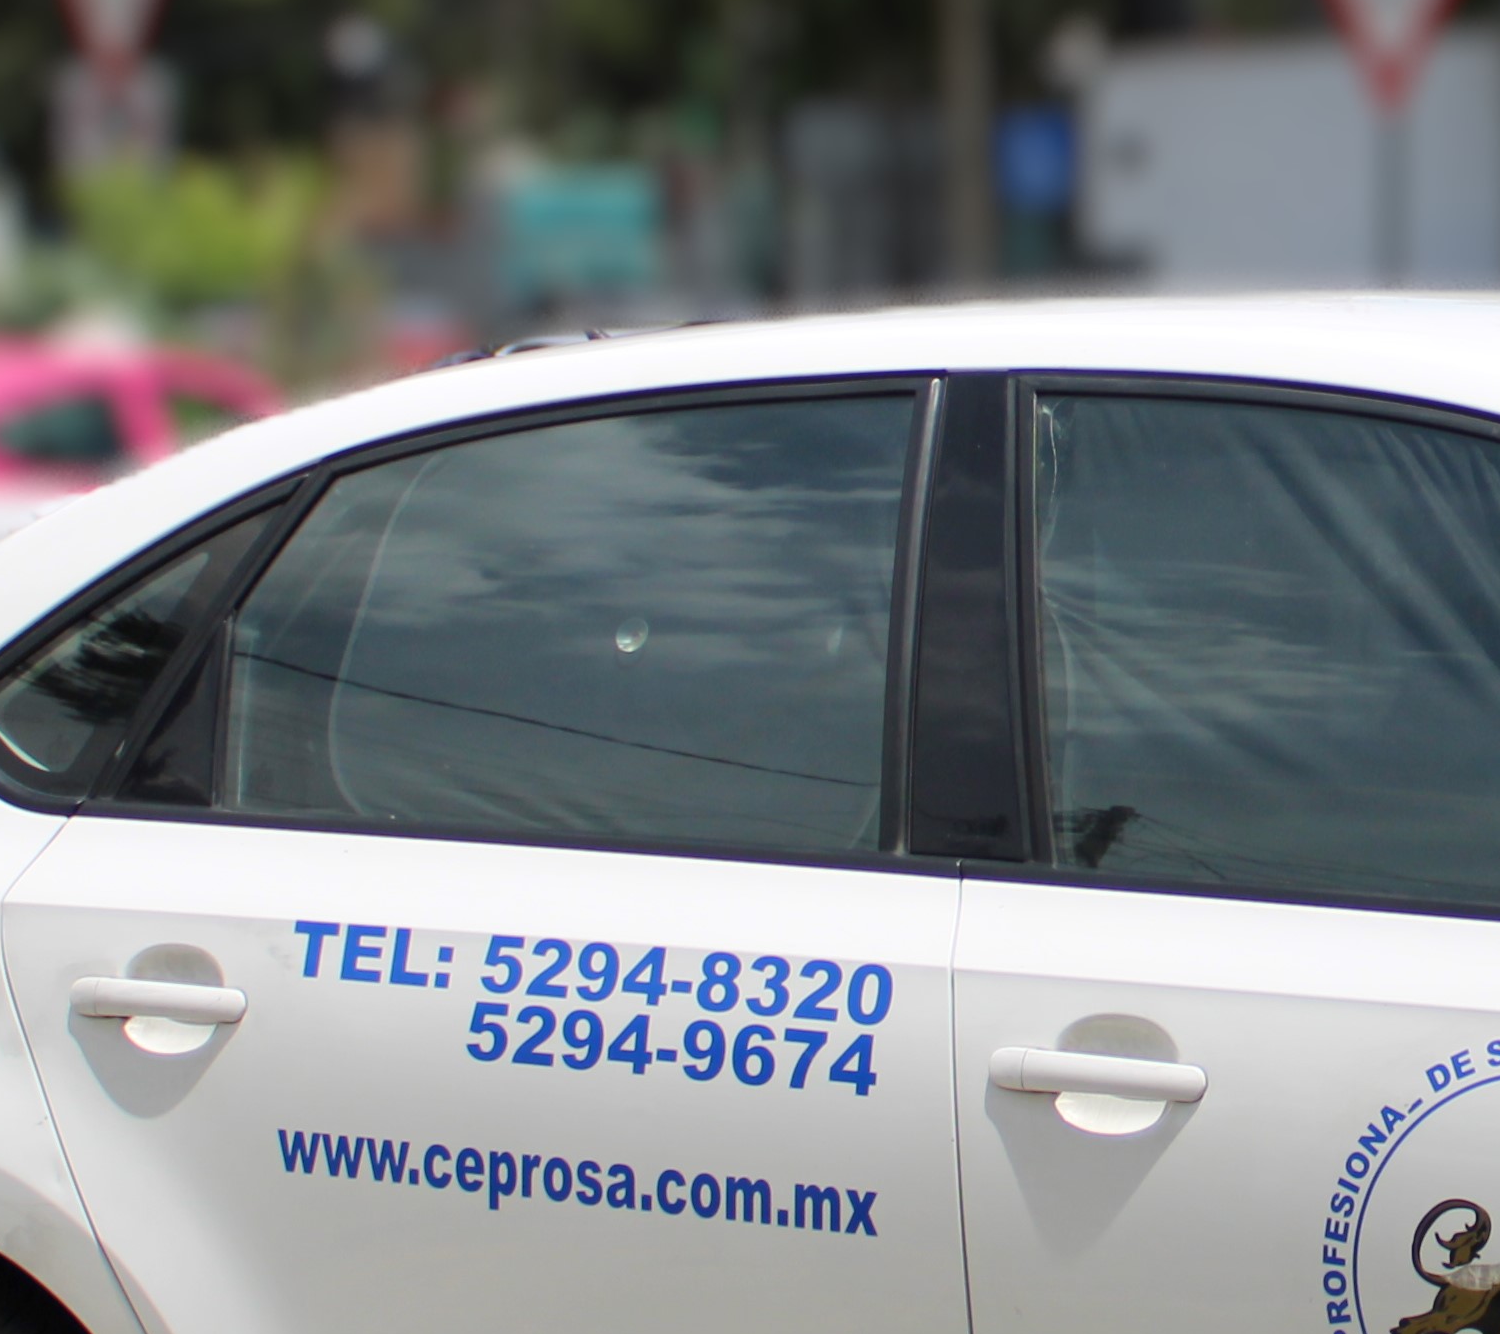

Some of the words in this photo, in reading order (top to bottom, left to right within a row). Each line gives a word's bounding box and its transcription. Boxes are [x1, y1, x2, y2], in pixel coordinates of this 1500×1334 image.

[292, 919, 454, 992] TEL:
[479, 934, 893, 1027] 5294-8320
[464, 1001, 877, 1097] 5294-9674
[1423, 1050, 1477, 1093] DE
[276, 1130, 876, 1237] www.ceprosa.com.mx
